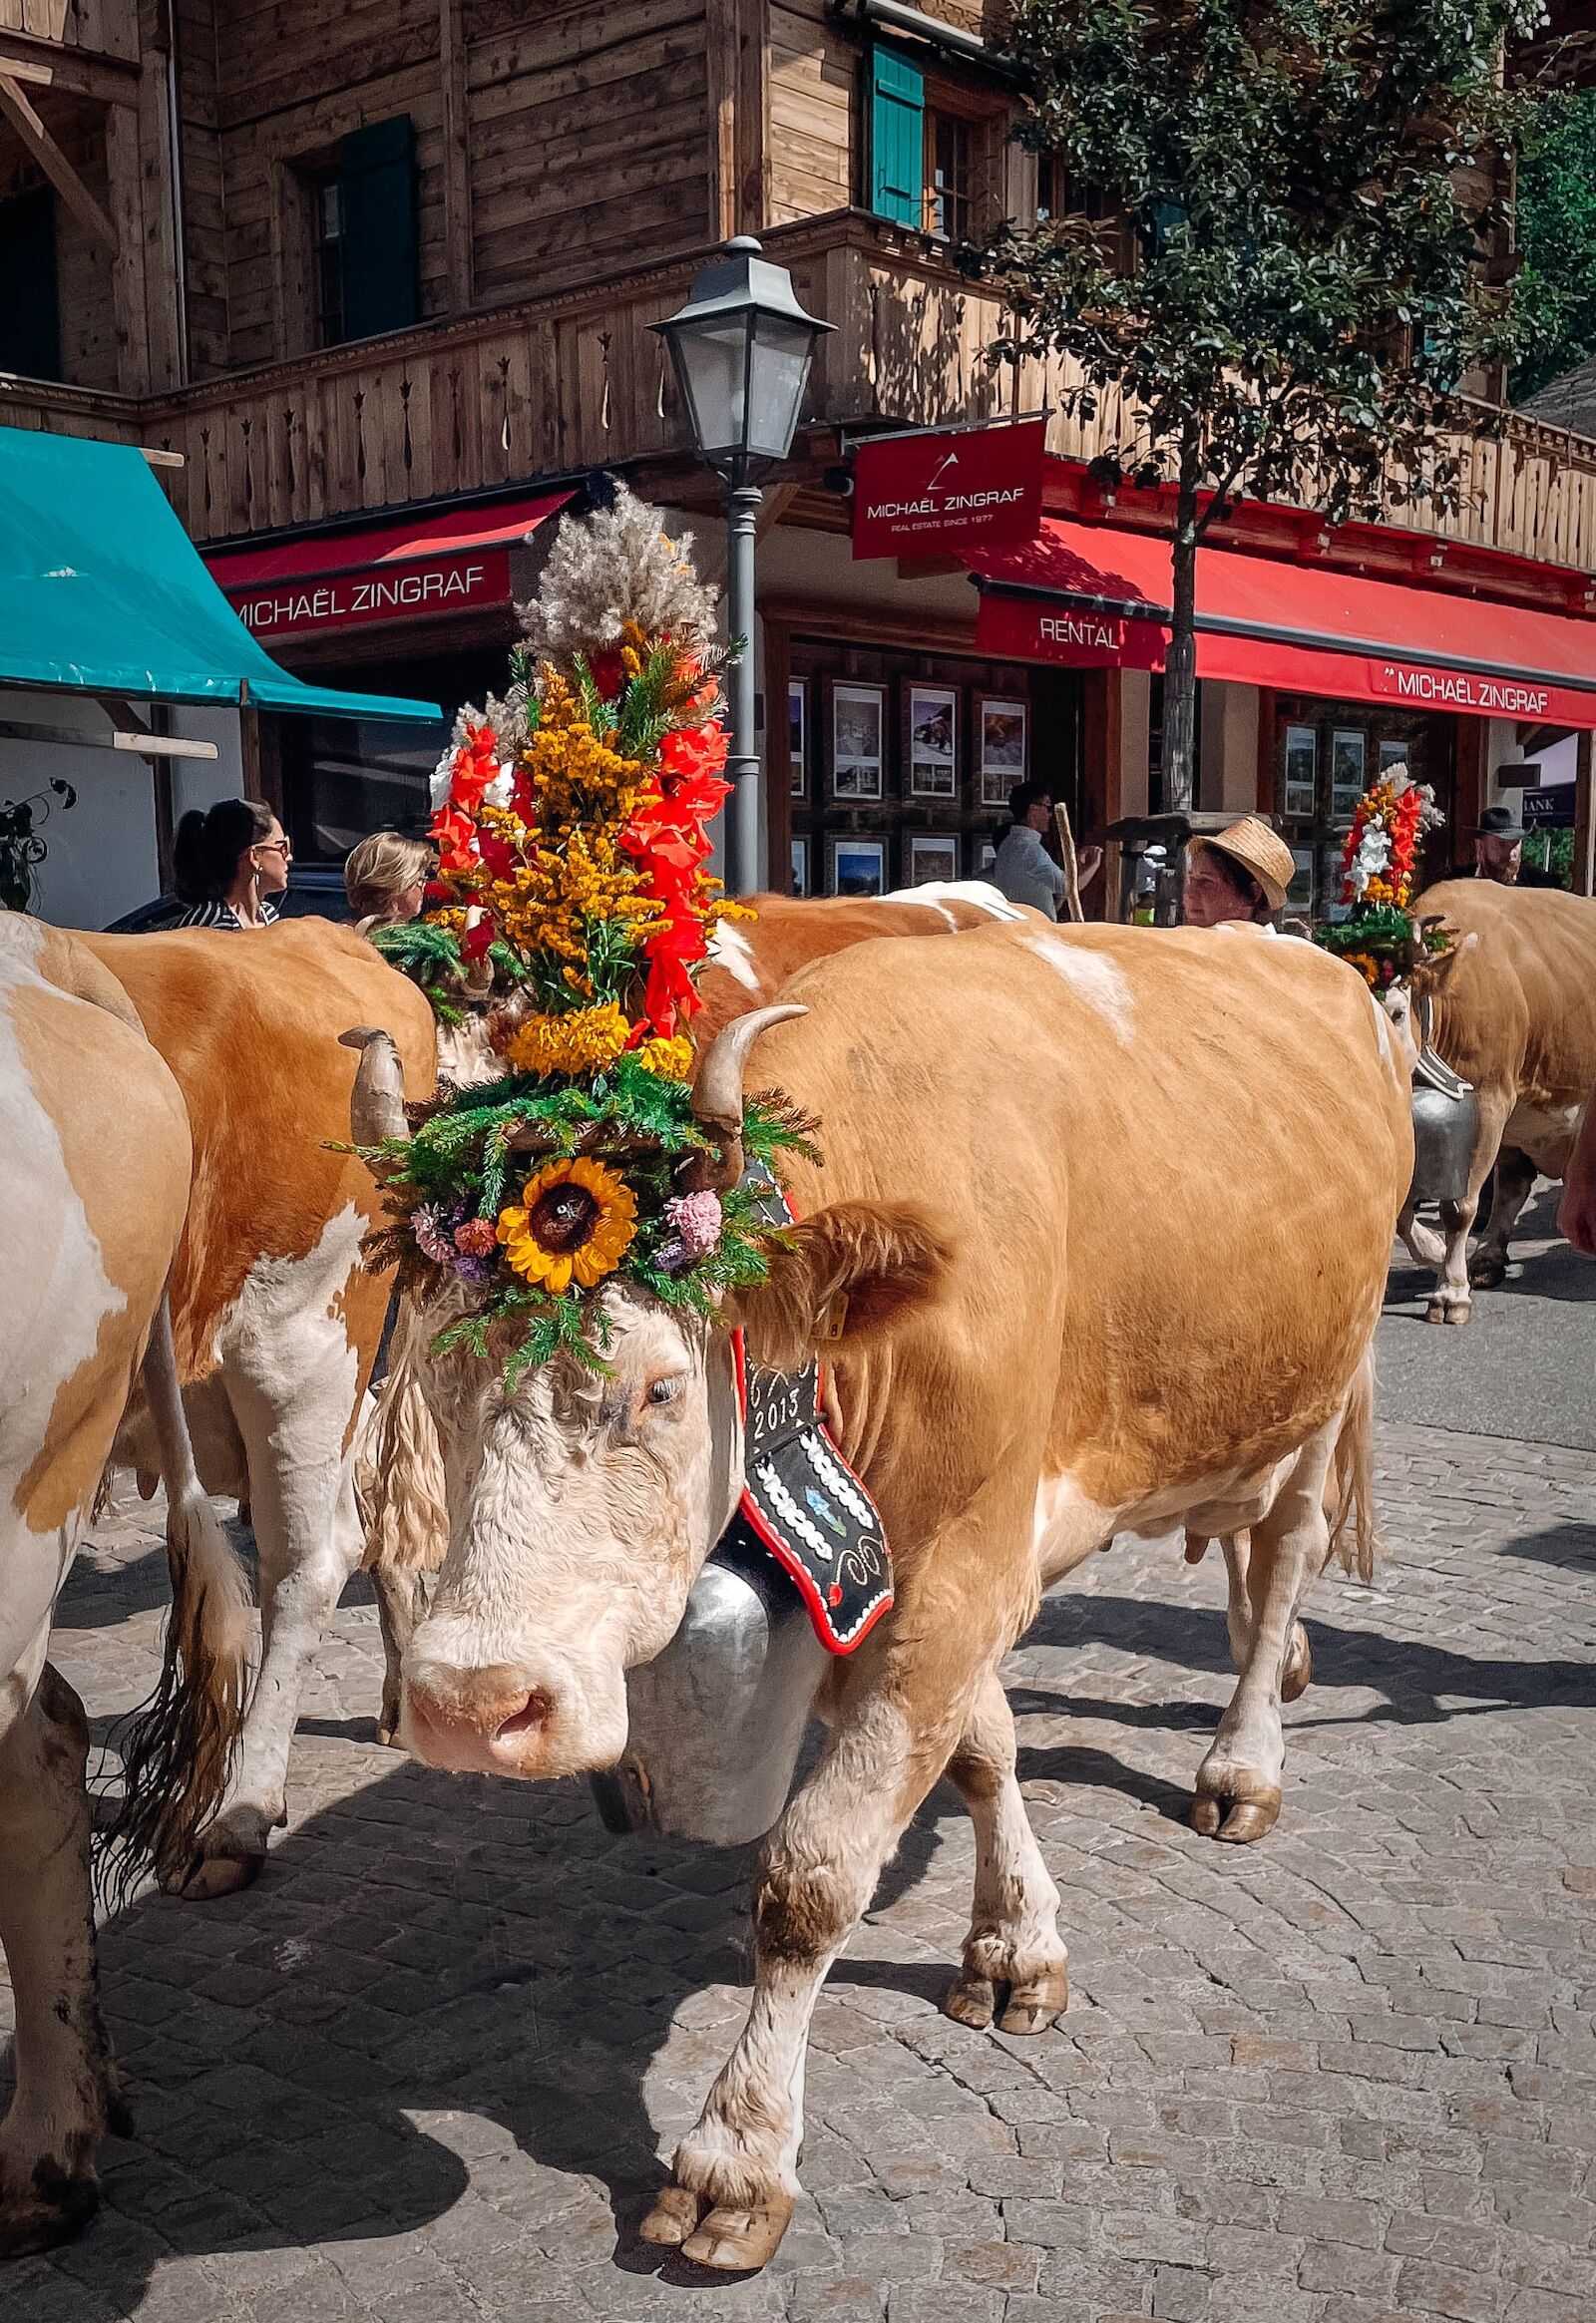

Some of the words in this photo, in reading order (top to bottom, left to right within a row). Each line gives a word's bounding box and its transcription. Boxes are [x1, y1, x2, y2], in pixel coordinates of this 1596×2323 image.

[866, 499, 940, 520] MICHAËL
[944, 488, 1024, 511] ZINGRAF
[891, 524, 910, 533] REAL
[912, 521, 941, 531] ESTATE
[944, 517, 968, 528] SINCE
[971, 514, 994, 524] 1977
[350, 566, 485, 611] ZINGRAF
[1039, 616, 1120, 649] RENTAL
[1397, 670, 1477, 705] MICHAËL
[1478, 682, 1548, 714] ZINGRAF
